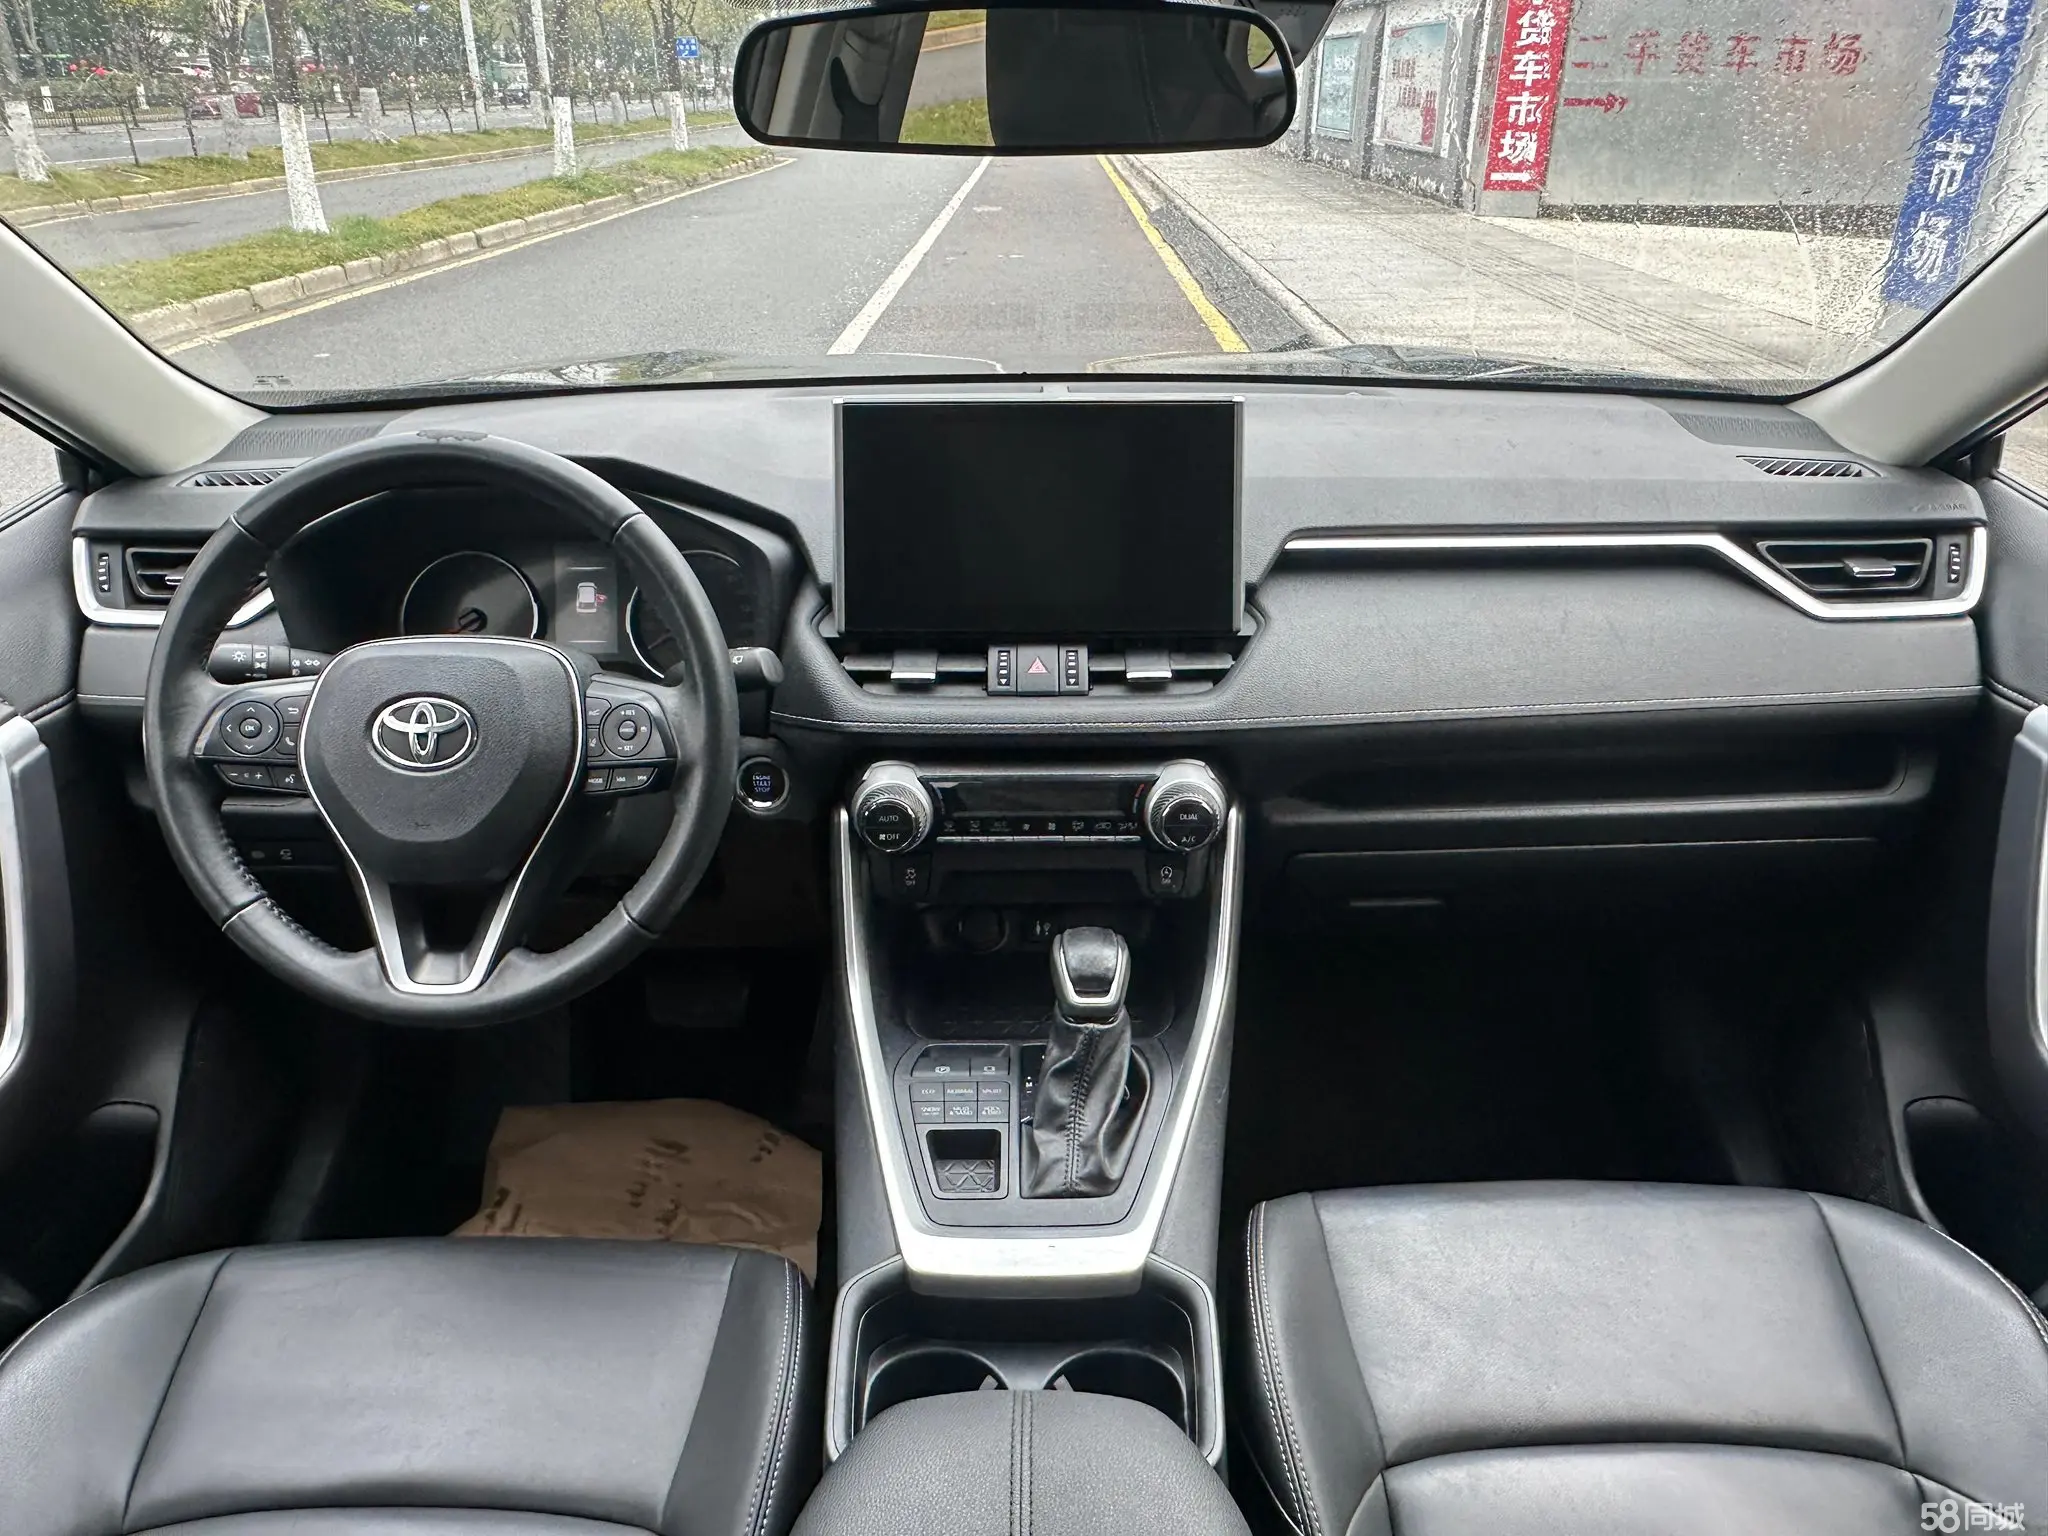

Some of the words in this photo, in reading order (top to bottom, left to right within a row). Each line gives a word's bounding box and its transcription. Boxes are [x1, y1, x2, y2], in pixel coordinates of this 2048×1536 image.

[1498, 0, 1556, 166] 货车市场
[879, 815, 900, 823] AUTO
[1179, 813, 1199, 821] DUAL
[1181, 835, 1197, 844] A/C
